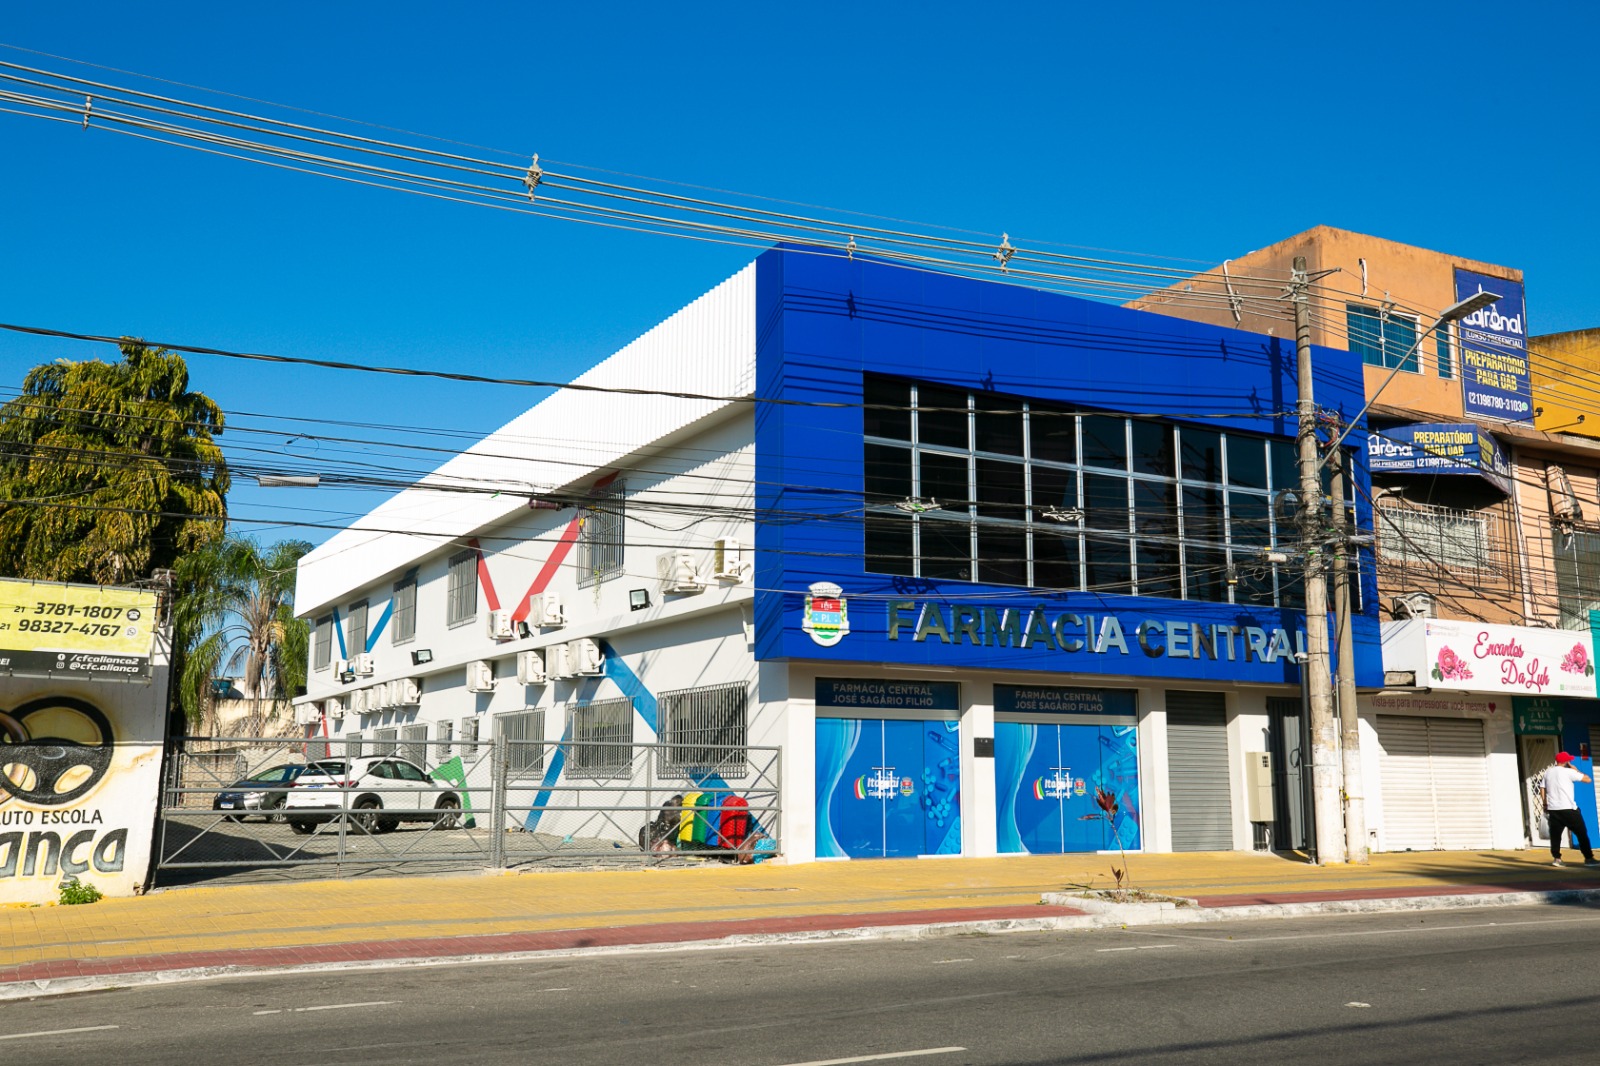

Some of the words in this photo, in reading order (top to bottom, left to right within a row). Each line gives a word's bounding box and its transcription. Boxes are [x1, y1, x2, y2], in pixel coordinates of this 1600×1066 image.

[1464, 349, 1526, 376] PREPARATÓRIO
[1476, 368, 1499, 388] PARA
[1500, 372, 1518, 391] OAB
[1413, 430, 1474, 444] PREPARATÓRIO
[1424, 444, 1447, 456] PARA
[1447, 445, 1465, 457] OAB
[13, 605, 26, 613] 21
[34, 602, 123, 620] 3781-1807
[0, 623, 11, 631] 21
[18, 618, 121, 637] 98327-4767
[886, 600, 1130, 655] FARMÁCIA
[1473, 631, 1524, 659] Encantos
[1500, 658, 1526, 685] Da
[1525, 658, 1550, 694] Luh
[832, 683, 885, 694] FARMÁCIA
[888, 686, 933, 696] CENTRAL
[1015, 690, 1060, 700] FARMÁCIA
[1063, 693, 1102, 702] CENTRAL
[832, 694, 857, 704] JOSÉ
[860, 695, 903, 705] SAGÁRIO
[905, 697, 934, 706] FILHO
[1015, 700, 1037, 710] JOSÉ
[1039, 701, 1077, 711] SAGÁRIO
[1078, 703, 1103, 712] FILHO
[1371, 696, 1395, 708] Vista-se
[1396, 697, 1410, 709] para
[1412, 698, 1449, 711] impressionar
[1465, 702, 1486, 712] mesma
[0, 811, 34, 826] UTO
[41, 809, 103, 825] ESCOLA
